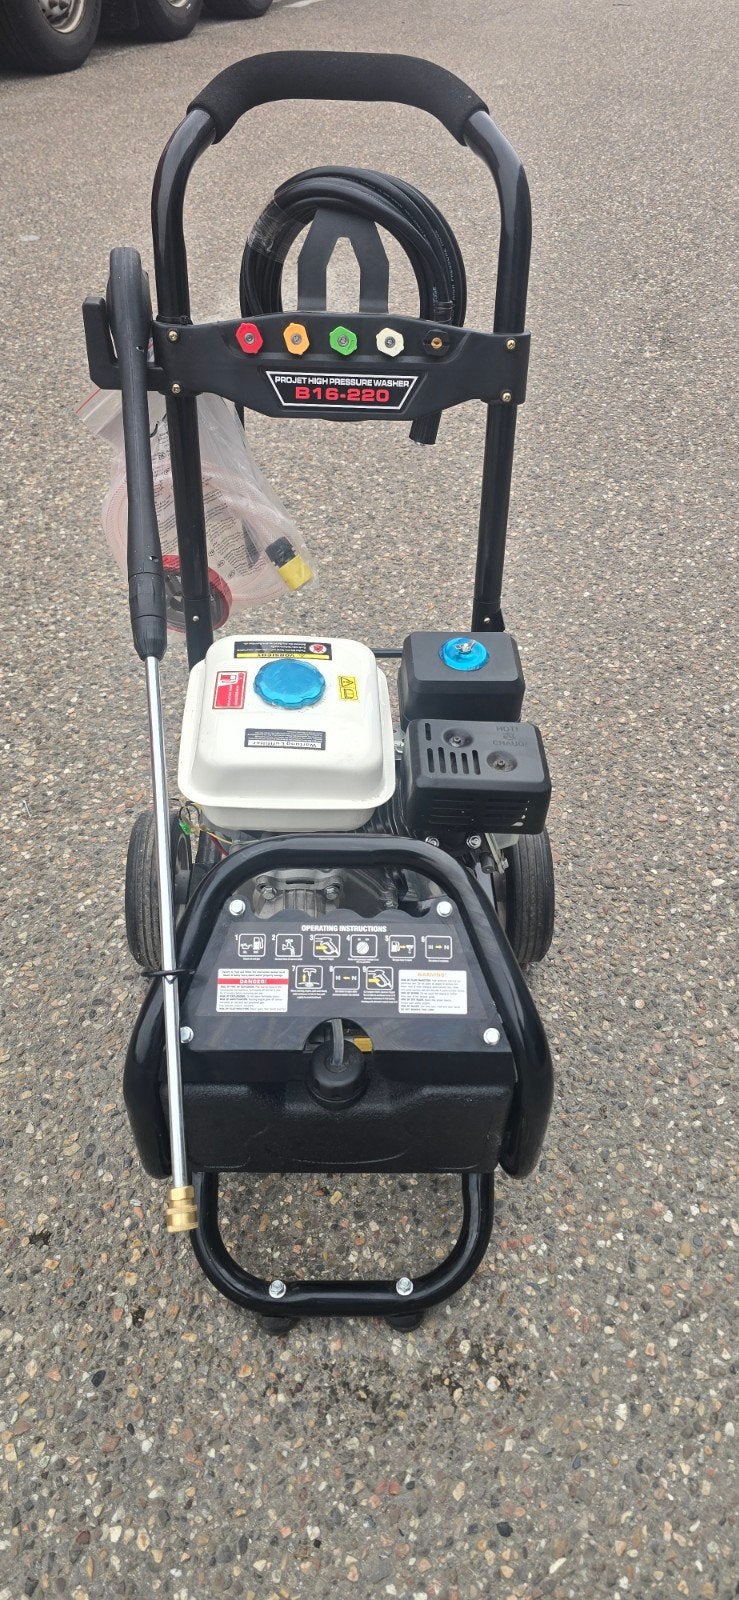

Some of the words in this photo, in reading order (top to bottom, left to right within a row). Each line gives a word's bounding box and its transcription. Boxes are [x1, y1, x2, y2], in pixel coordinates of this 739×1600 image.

[275, 376, 307, 384] PROJET
[308, 377, 329, 385] HIGH
[329, 378, 373, 387] PRESSURE
[374, 379, 410, 388] WASHER
[295, 386, 390, 402] B16-220
